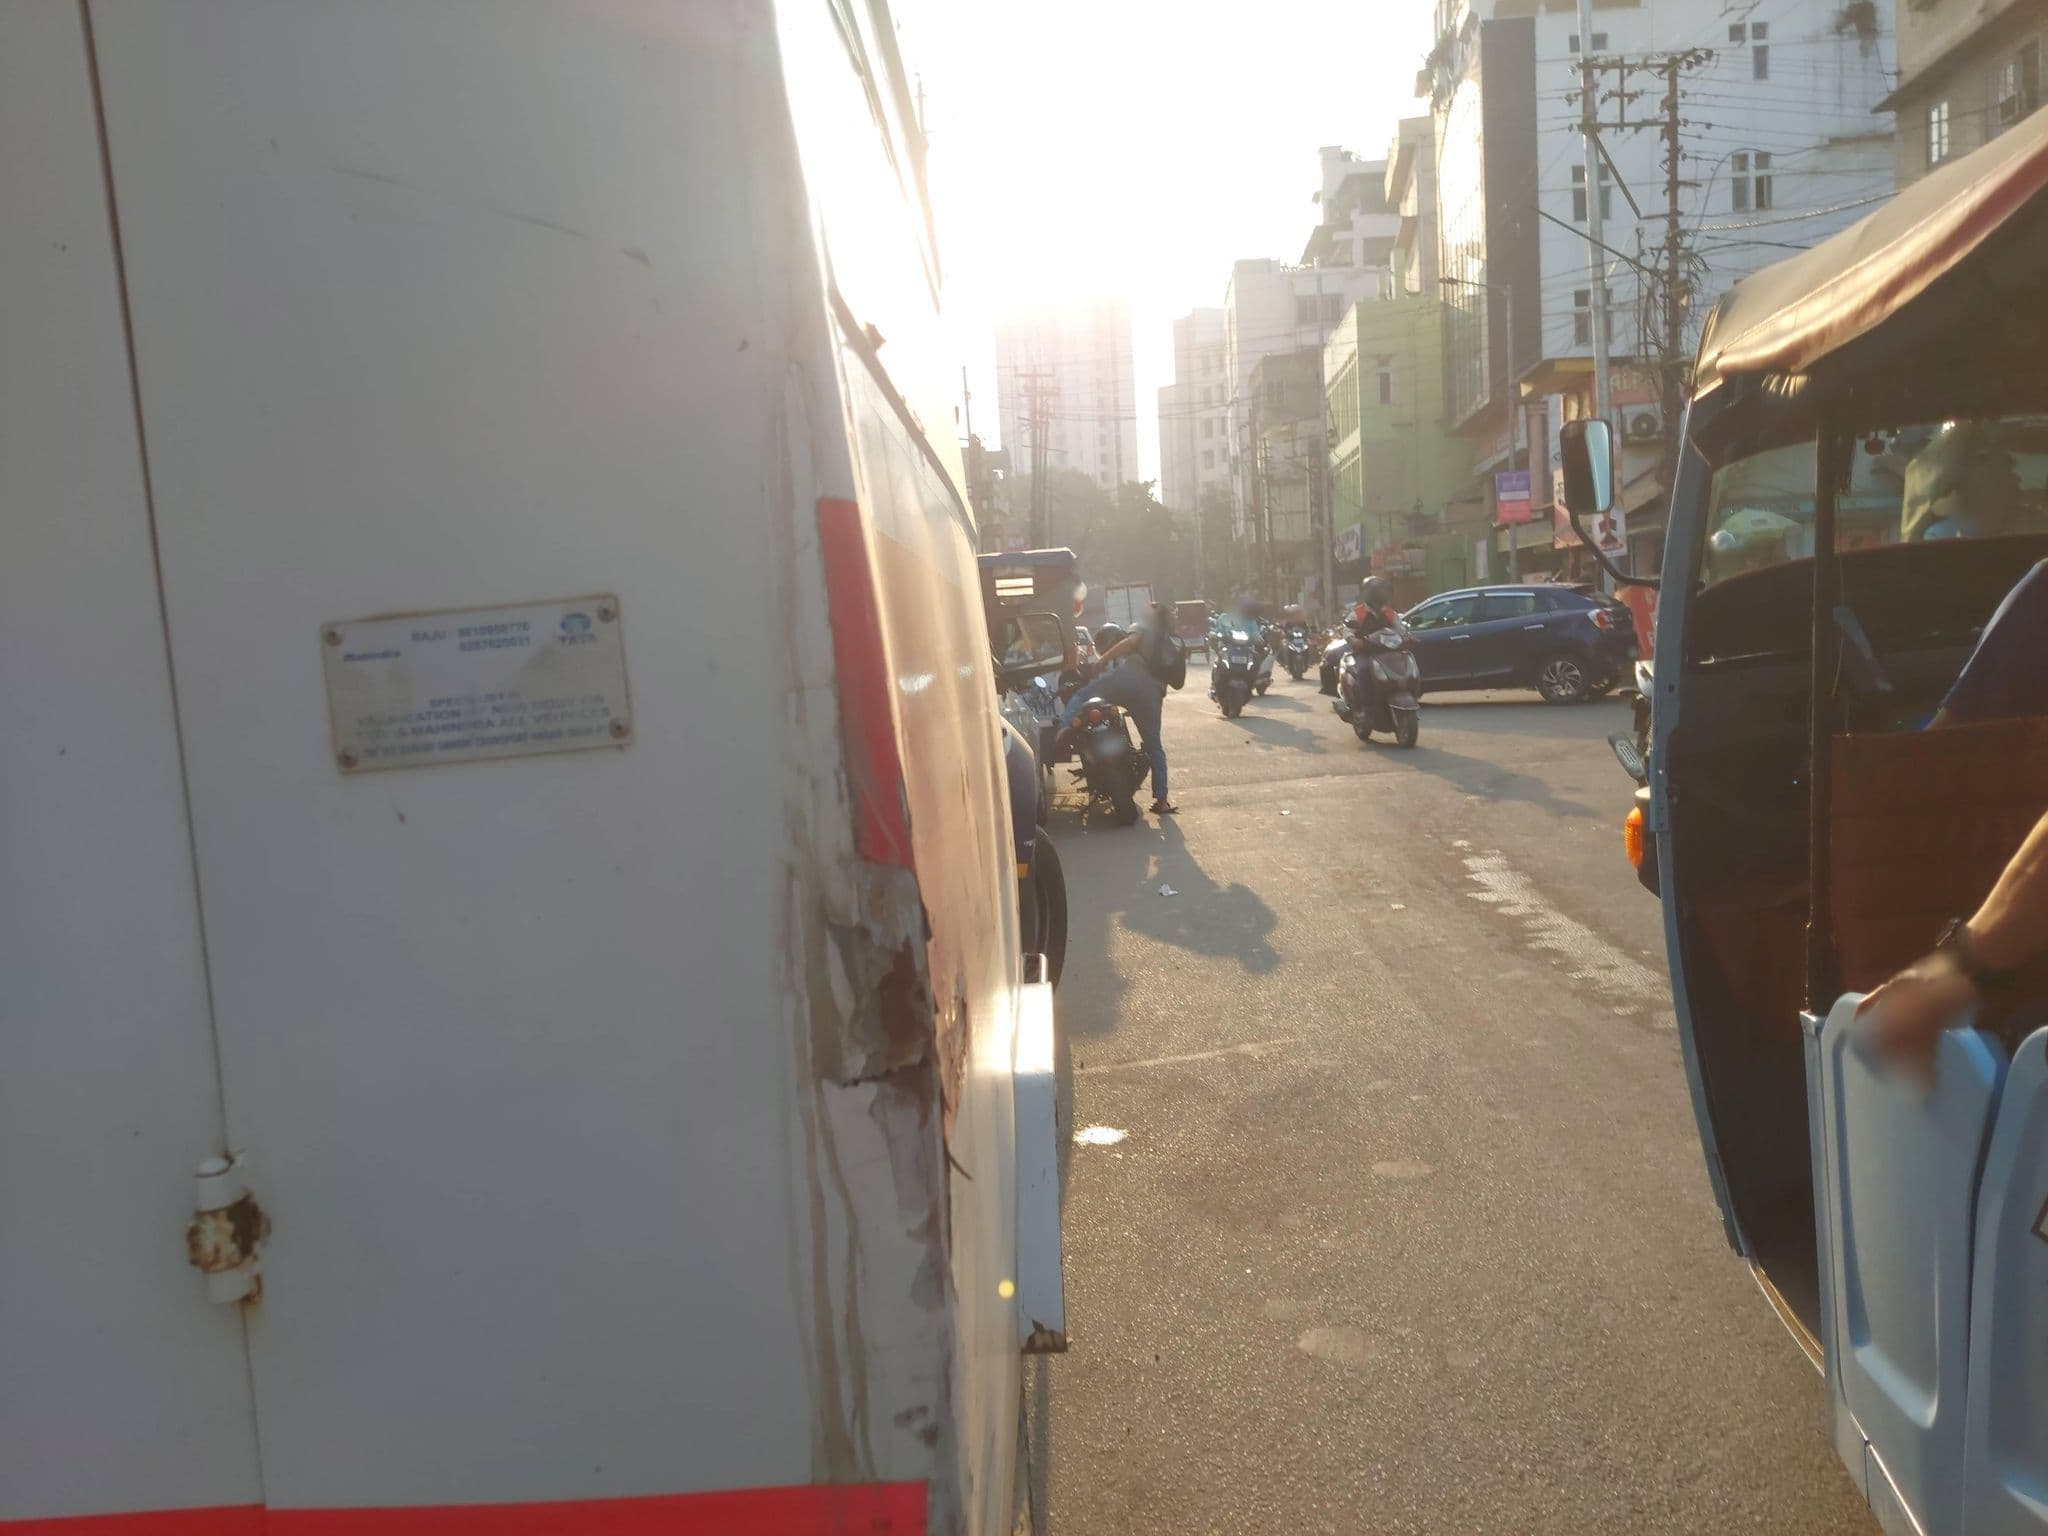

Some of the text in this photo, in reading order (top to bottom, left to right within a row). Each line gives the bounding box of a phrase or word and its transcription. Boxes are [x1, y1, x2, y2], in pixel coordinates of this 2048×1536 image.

[557, 633, 598, 647] TATA
[429, 692, 506, 708] SPECLIST
[410, 718, 495, 736] MAHINA
